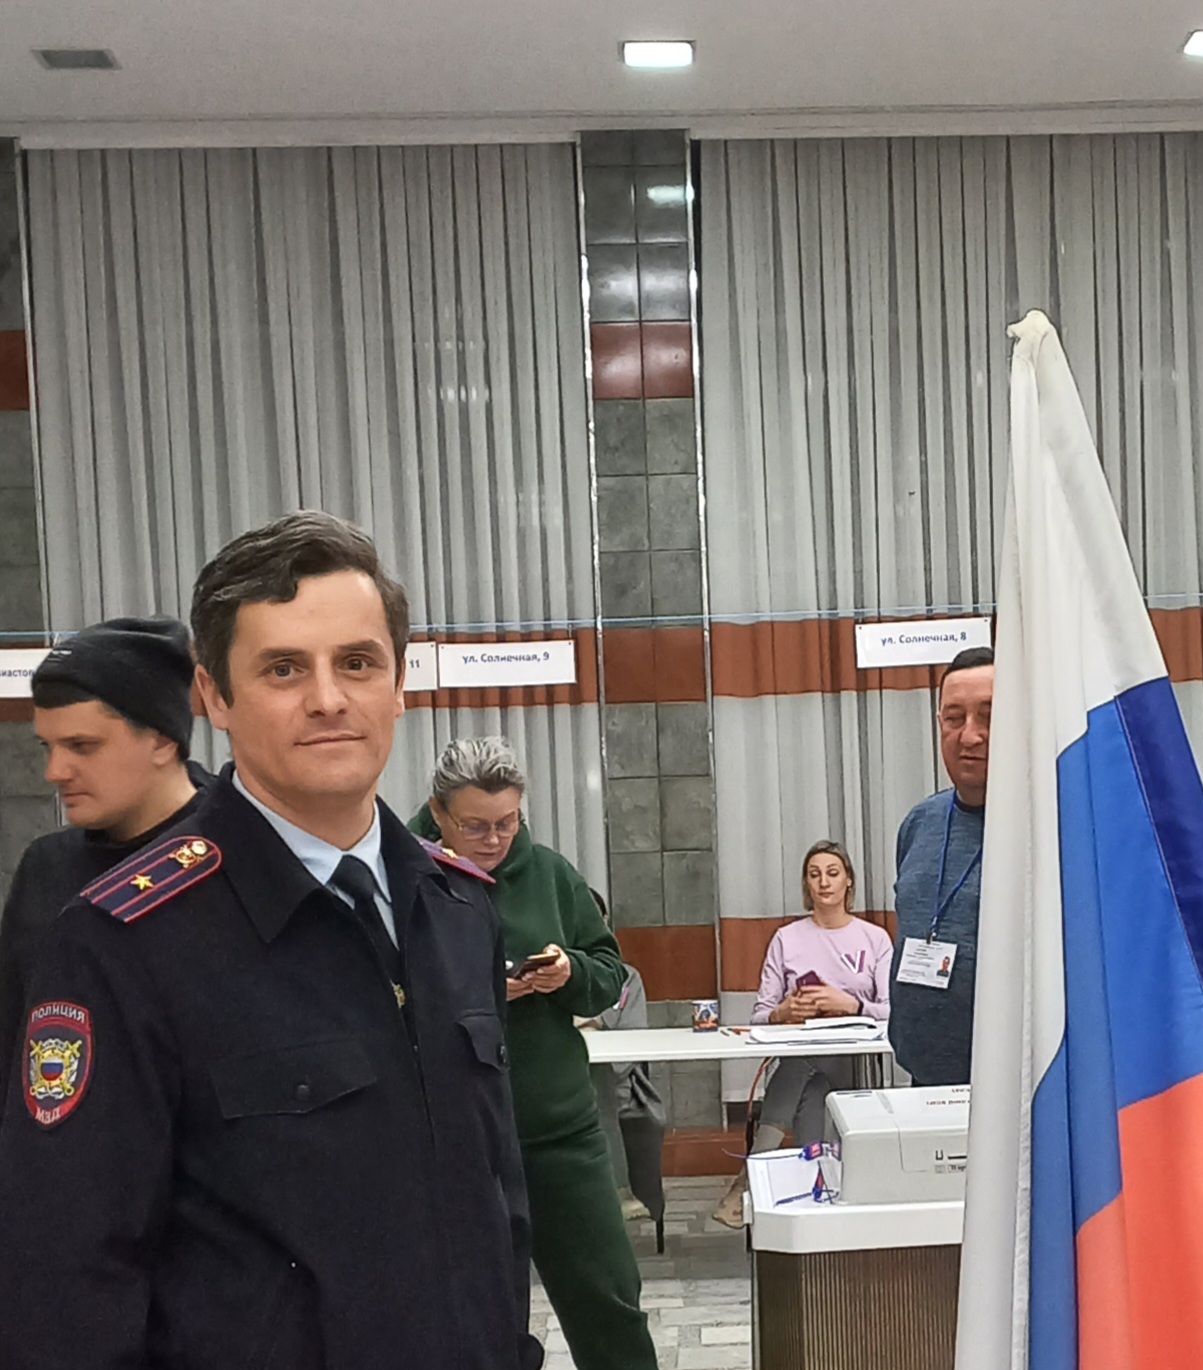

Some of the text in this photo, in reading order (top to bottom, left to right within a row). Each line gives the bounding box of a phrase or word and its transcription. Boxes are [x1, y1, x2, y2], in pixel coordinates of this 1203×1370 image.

[881, 632, 967, 646] ул. Солнечная, 8
[409, 659, 420, 668] 11
[462, 651, 550, 665] ул. Солнечная, 9
[31, 1004, 85, 1024] ПОЛИЦИЯ
